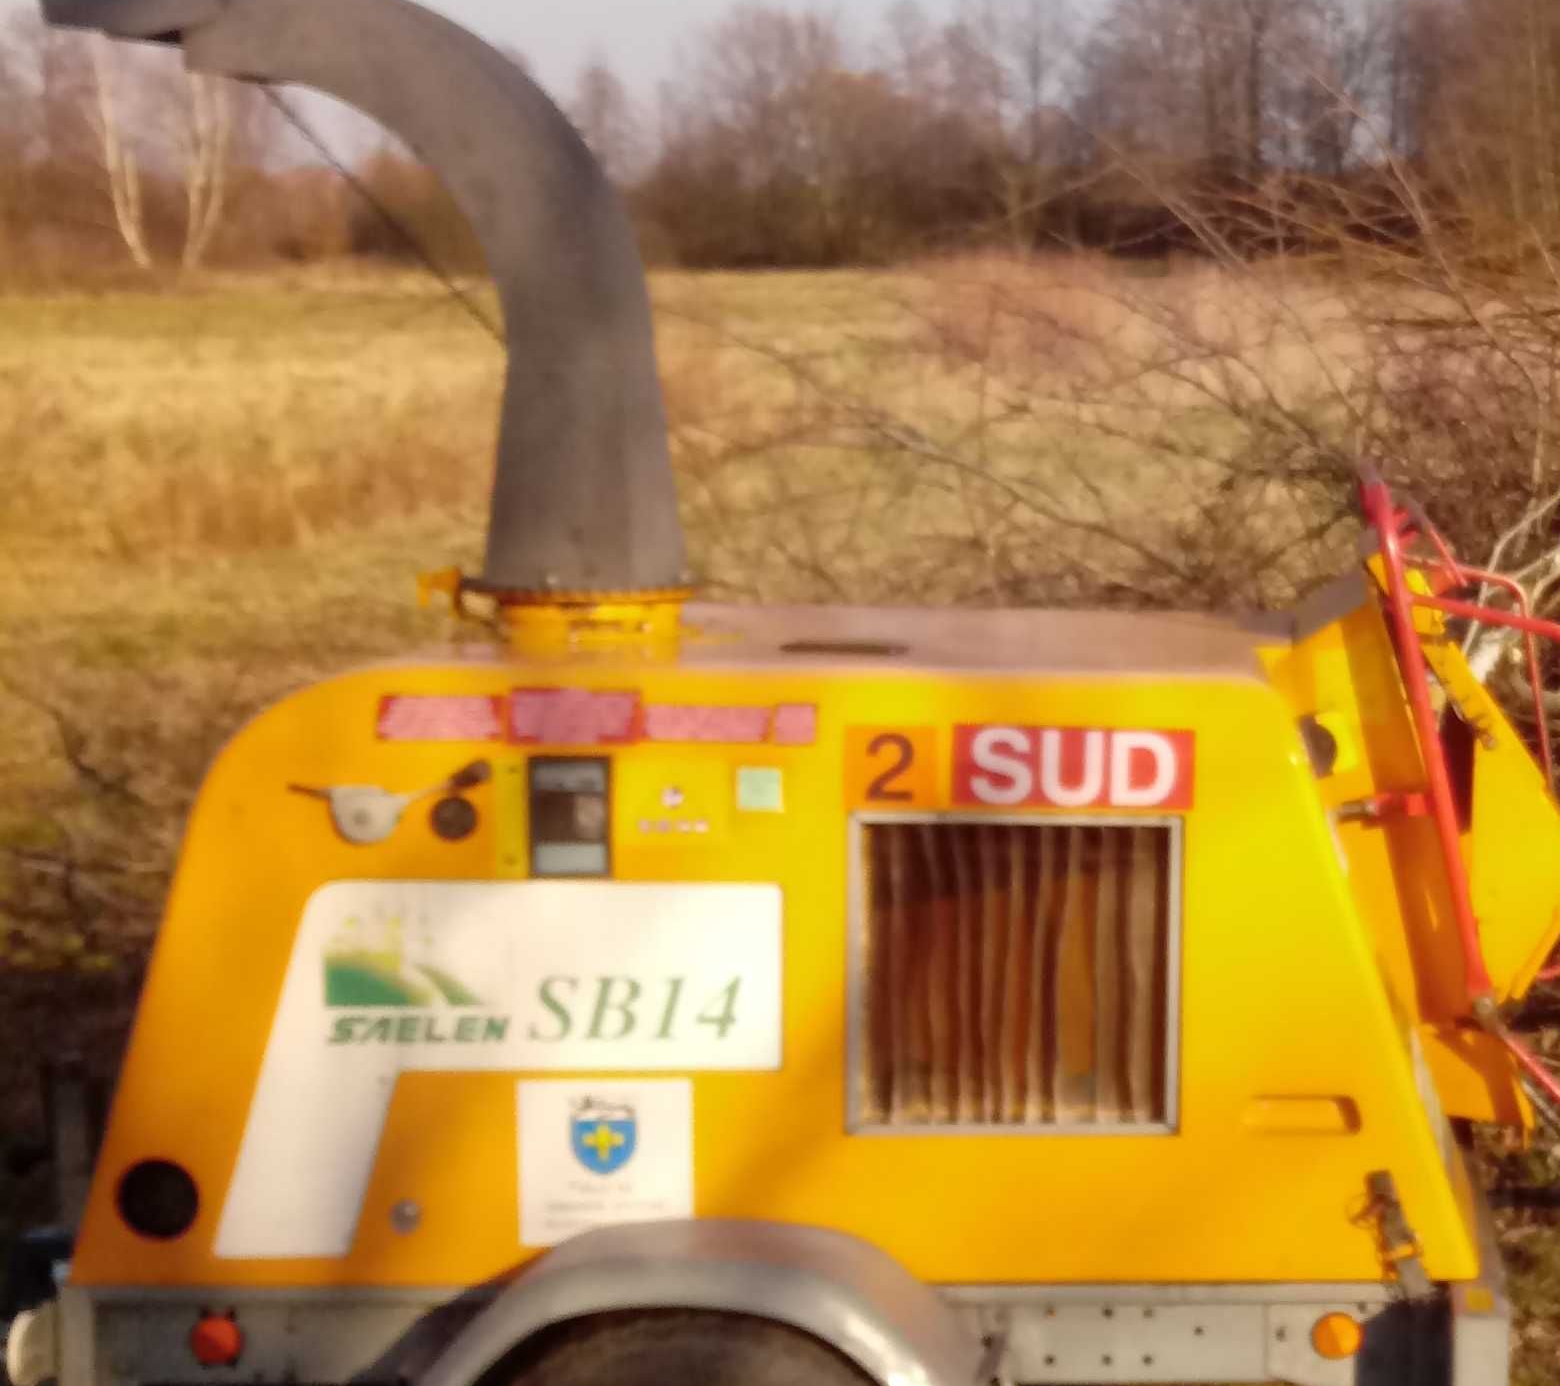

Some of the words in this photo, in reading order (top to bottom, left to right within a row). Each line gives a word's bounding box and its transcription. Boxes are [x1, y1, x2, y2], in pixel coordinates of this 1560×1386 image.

[864, 731, 915, 802] 2
[969, 726, 1179, 808] SUD
[327, 1016, 509, 1045] SAELEN
[527, 975, 743, 1043] SB14
